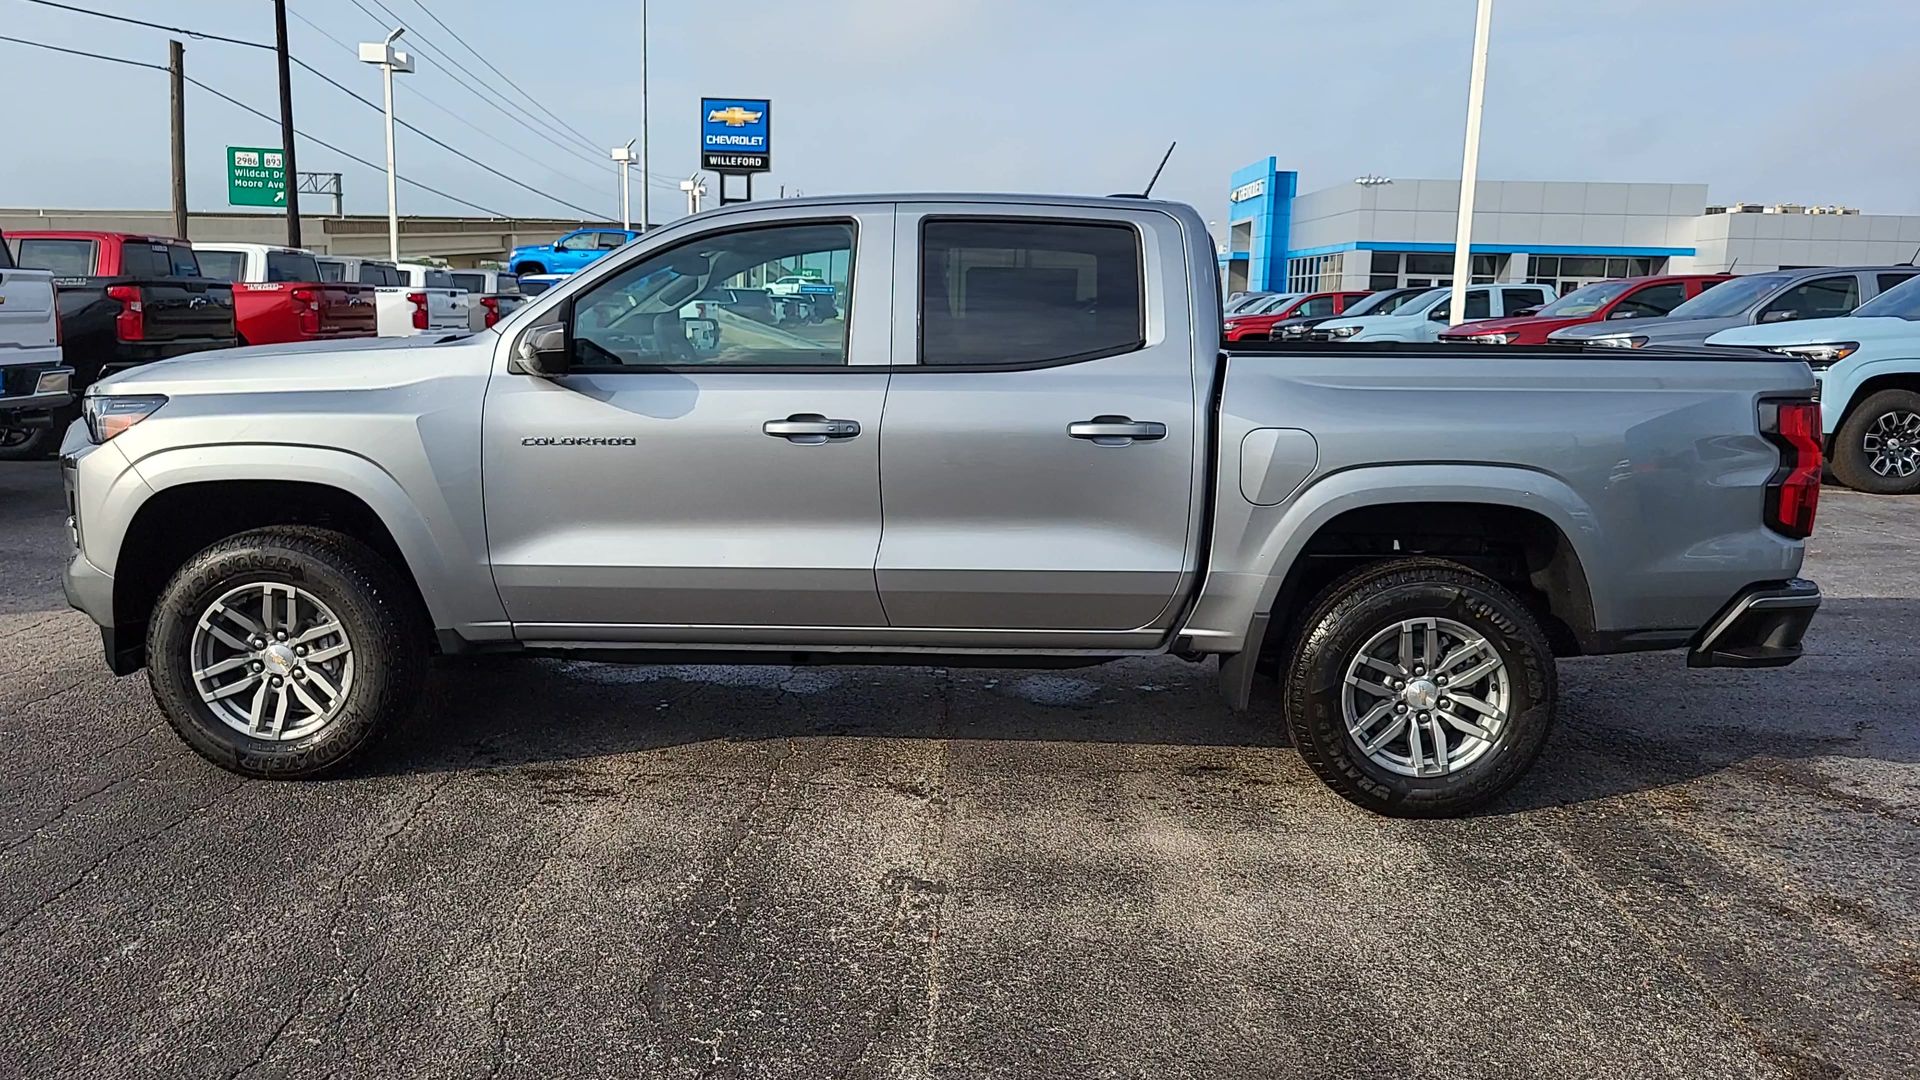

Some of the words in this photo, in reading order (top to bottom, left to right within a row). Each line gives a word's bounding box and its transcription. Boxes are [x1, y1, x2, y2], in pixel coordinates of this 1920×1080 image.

[706, 135, 763, 145] CHEVROLET
[236, 156, 257, 165] 2986
[265, 158, 281, 167] 893
[709, 156, 761, 165] WILLEFORD
[234, 169, 269, 177] Wildcat
[235, 179, 263, 187] Moore
[522, 437, 637, 447] COLORADO
